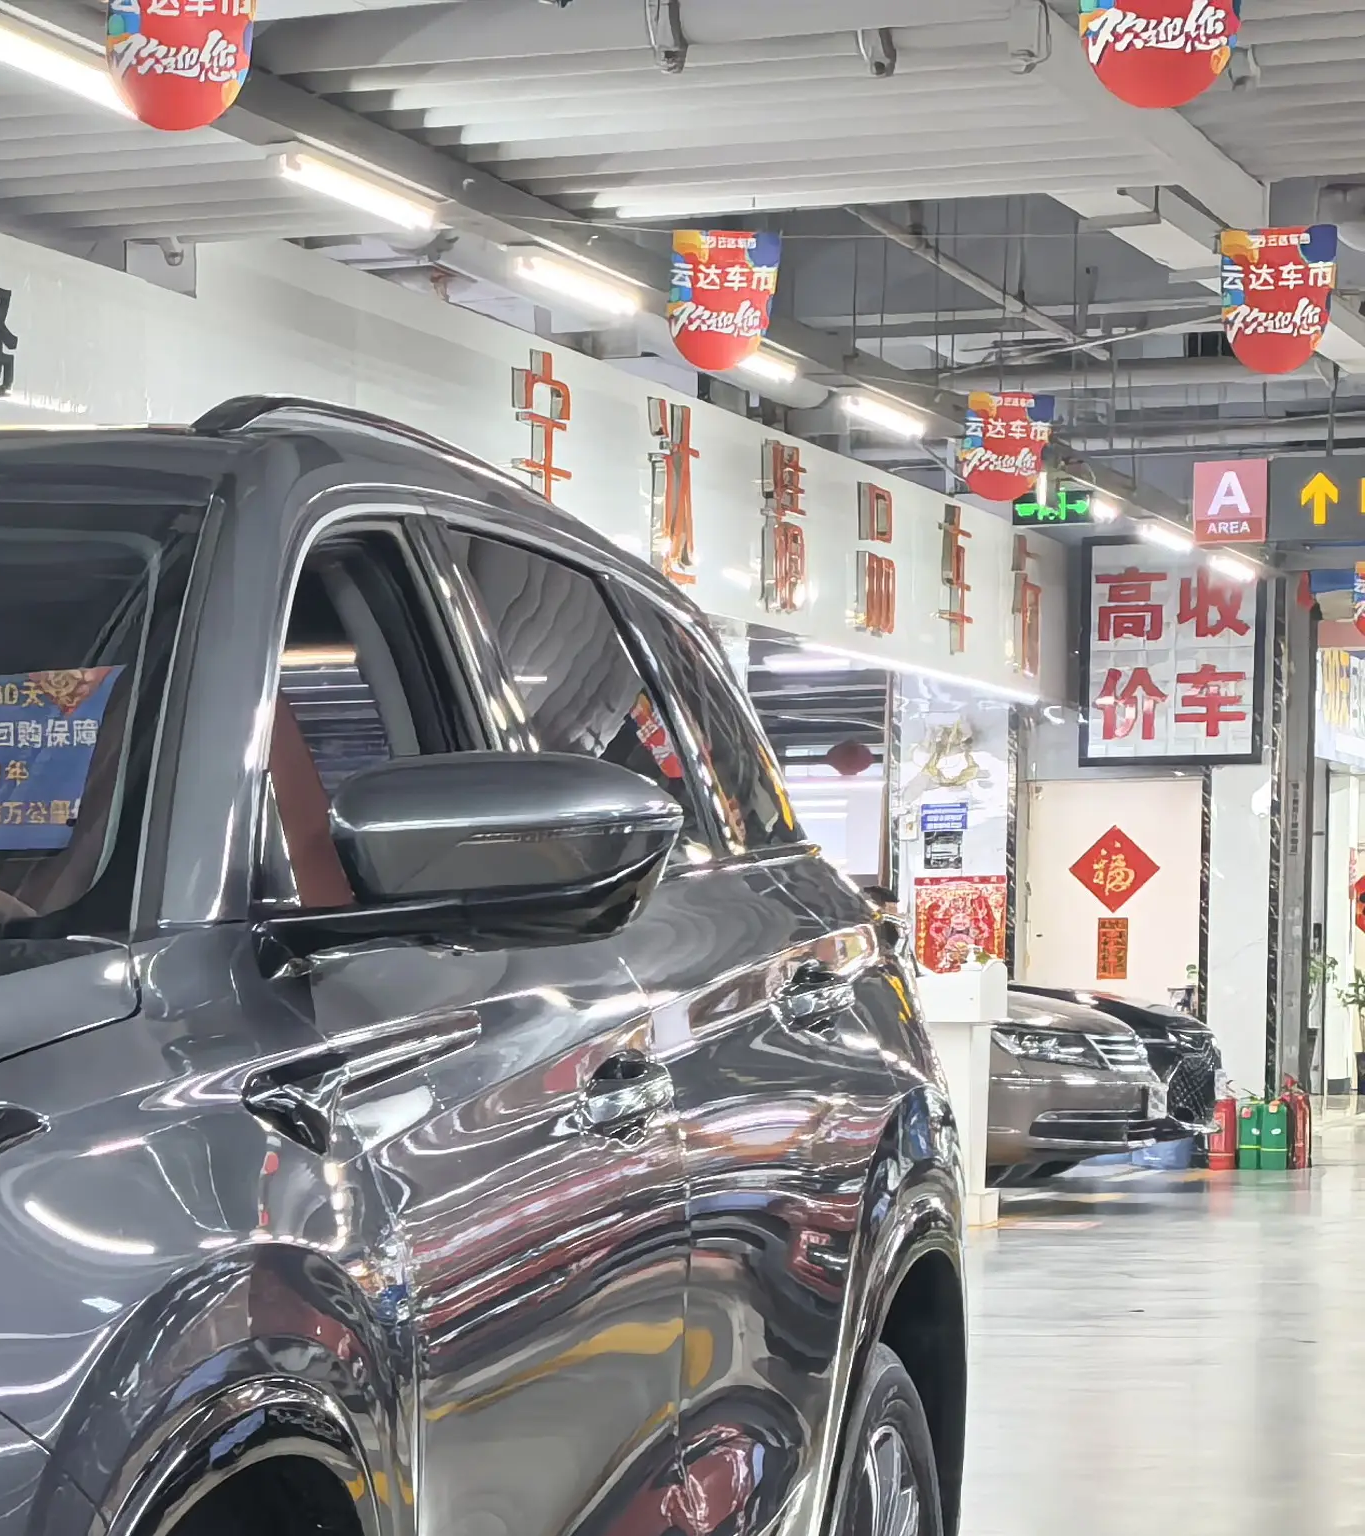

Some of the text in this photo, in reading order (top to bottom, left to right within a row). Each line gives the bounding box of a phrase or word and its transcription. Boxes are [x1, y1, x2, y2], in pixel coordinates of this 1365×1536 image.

[1088, 0, 1228, 65] 欢迎您
[113, 29, 238, 83] 欢迎您
[670, 262, 777, 292] 云达车市
[1221, 261, 1334, 290] 云达车市
[671, 299, 762, 338] 欢迎您
[1226, 297, 1322, 344] 欢迎您
[965, 417, 1051, 442] 云达车市
[963, 446, 1038, 477] 欢迎您
[1207, 470, 1251, 515] A
[1207, 520, 1251, 535] AREA
[1092, 840, 1136, 897] 福
